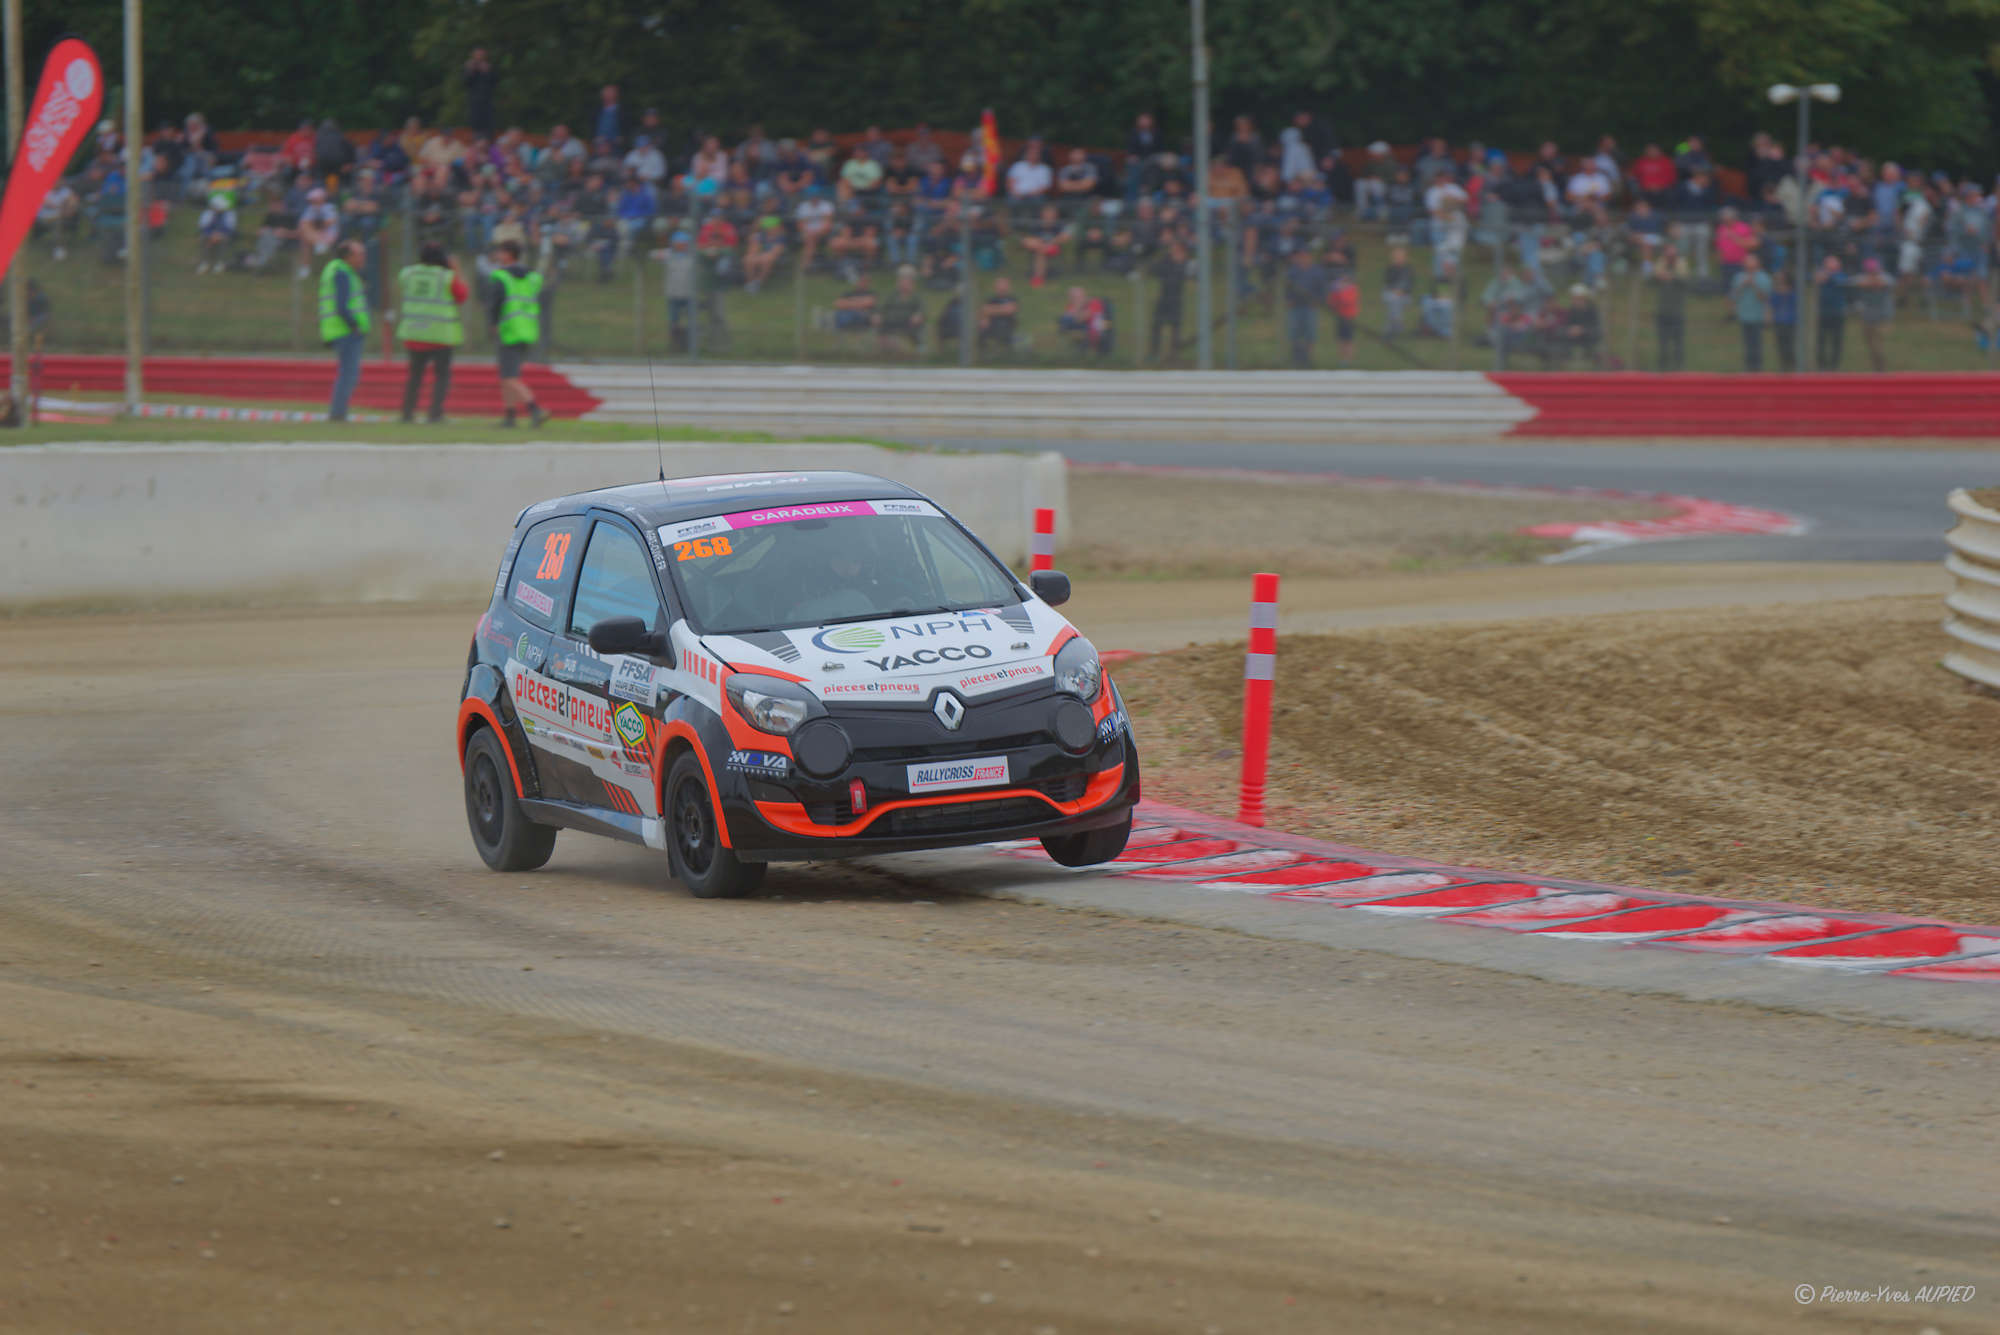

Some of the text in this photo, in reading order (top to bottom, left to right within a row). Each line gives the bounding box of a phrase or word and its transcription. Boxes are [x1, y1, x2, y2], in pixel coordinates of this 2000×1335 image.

[752, 505, 854, 521] CARADEUX
[536, 533, 571, 580] 268
[673, 536, 733, 562] 268
[890, 618, 992, 639] NPH
[864, 645, 992, 671] YACCO
[620, 715, 642, 734] YACCO
[917, 765, 974, 783] RALLYCROSS
